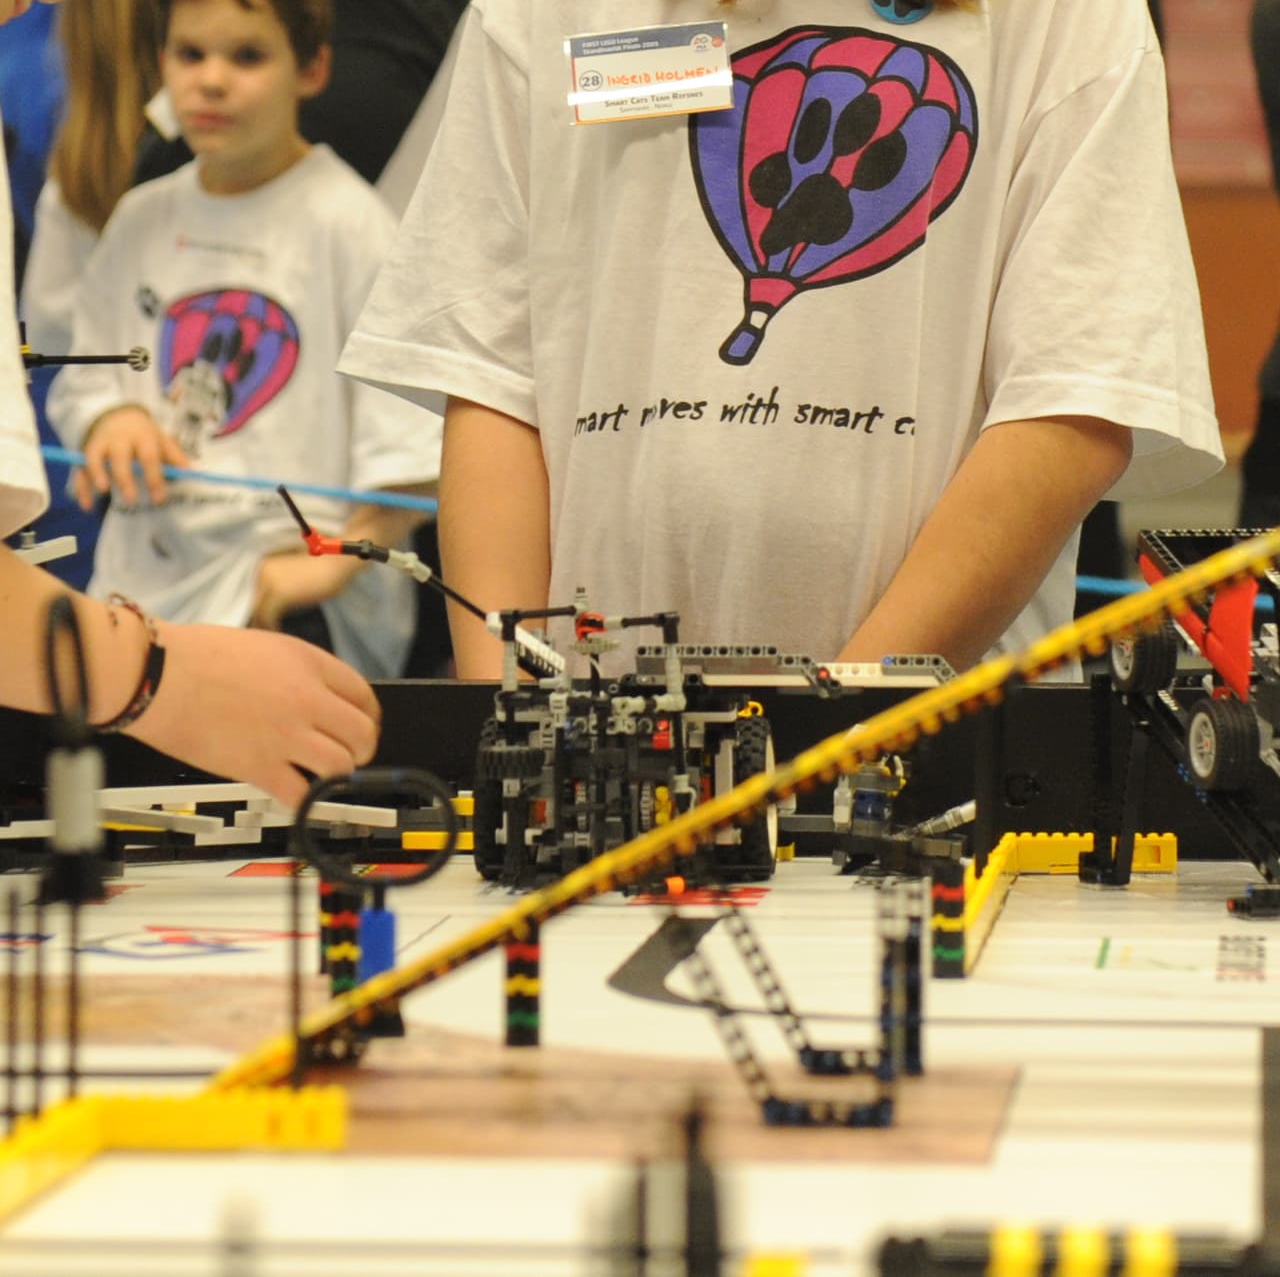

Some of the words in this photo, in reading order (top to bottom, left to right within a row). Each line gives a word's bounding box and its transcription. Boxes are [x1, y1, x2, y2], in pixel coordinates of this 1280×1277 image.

[581, 75, 600, 88] 28
[574, 402, 630, 438] mart
[719, 385, 780, 426] with
[793, 401, 884, 435] smart
